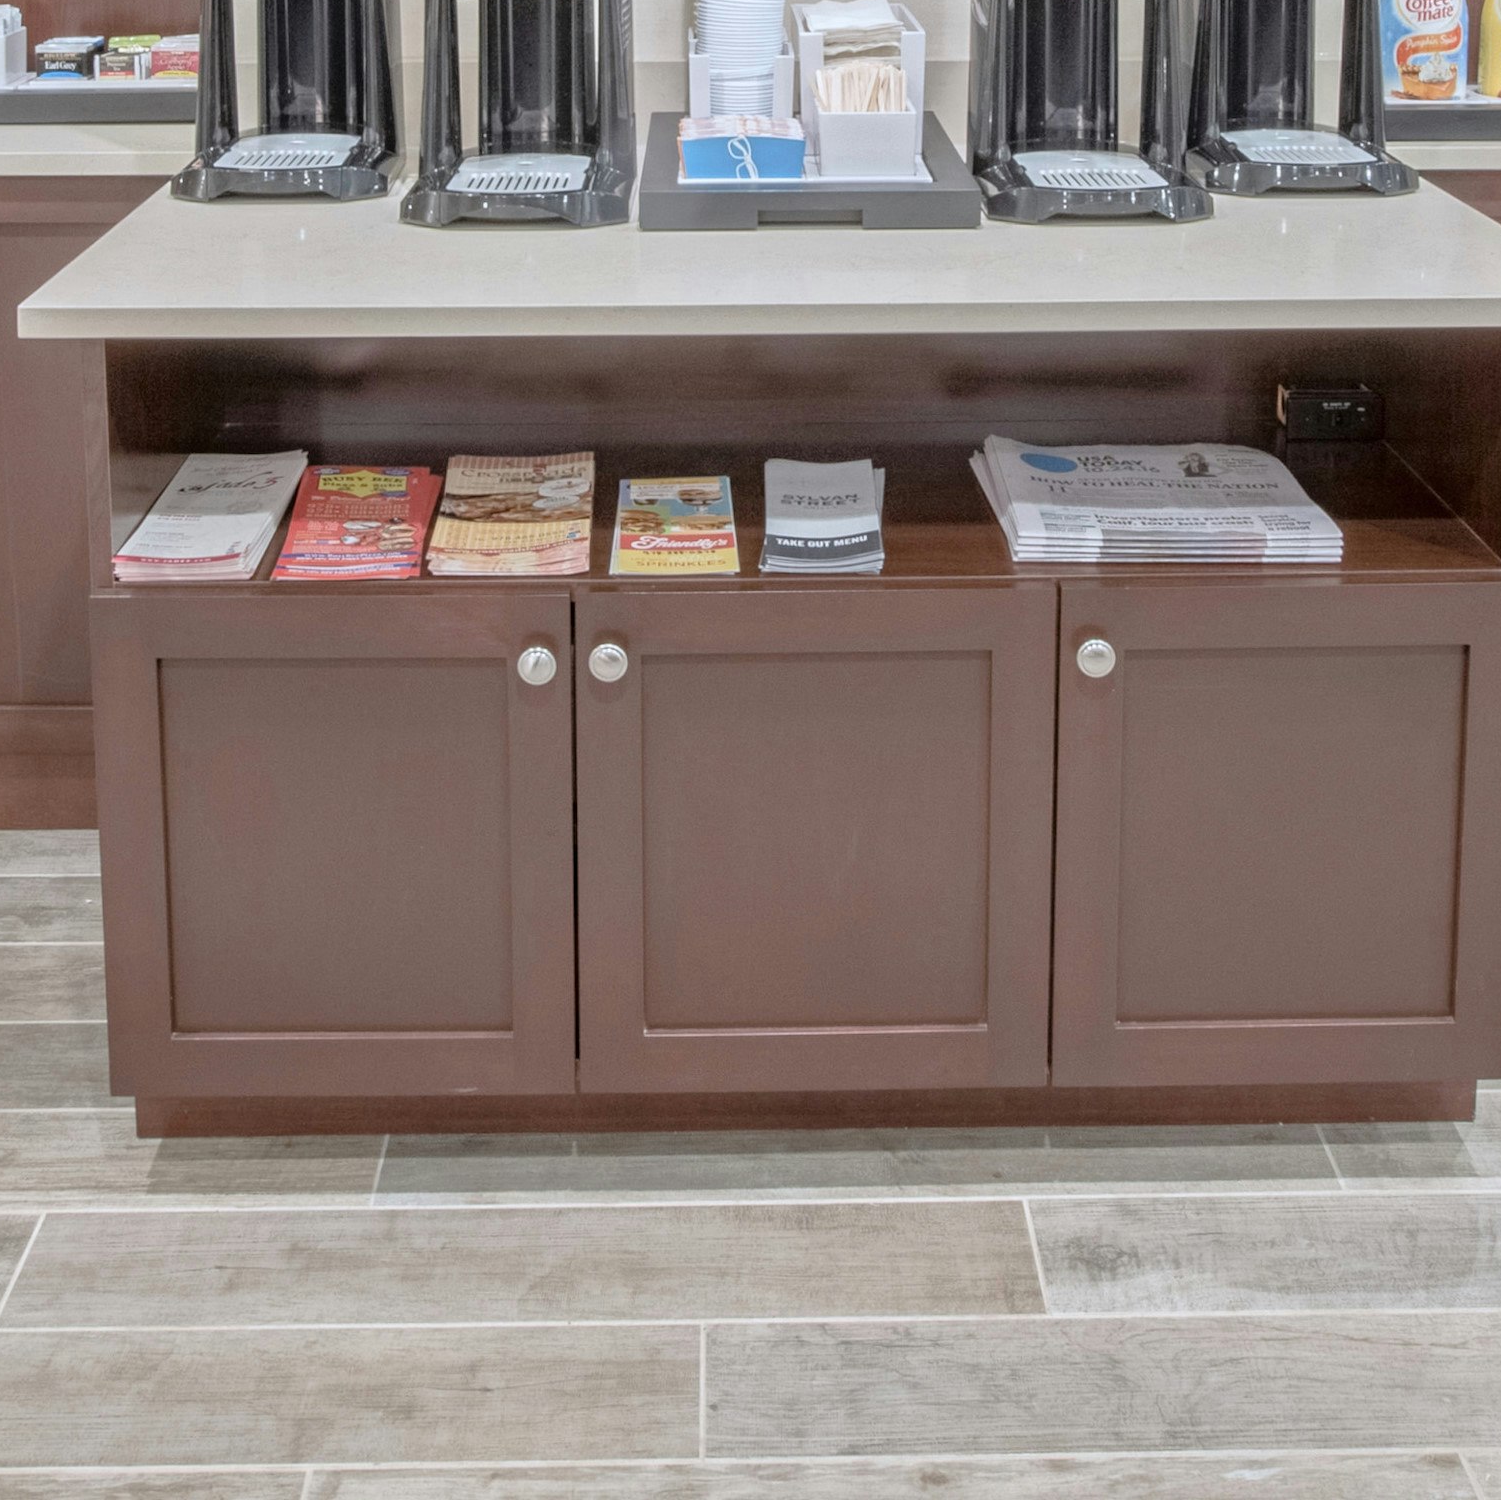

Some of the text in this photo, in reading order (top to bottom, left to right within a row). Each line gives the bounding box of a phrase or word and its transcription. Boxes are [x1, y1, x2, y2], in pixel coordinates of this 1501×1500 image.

[1417, 5, 1454, 23] mate
[44, 60, 77, 71] Earl Grey
[1030, 475, 1074, 485] HOW
[1110, 480, 1161, 488] HEAL
[780, 498, 860, 506] STREET
[783, 493, 858, 501] SYLVAN
[630, 535, 729, 549] Friendly's
[775, 535, 868, 548] TAKE OUT MENU
